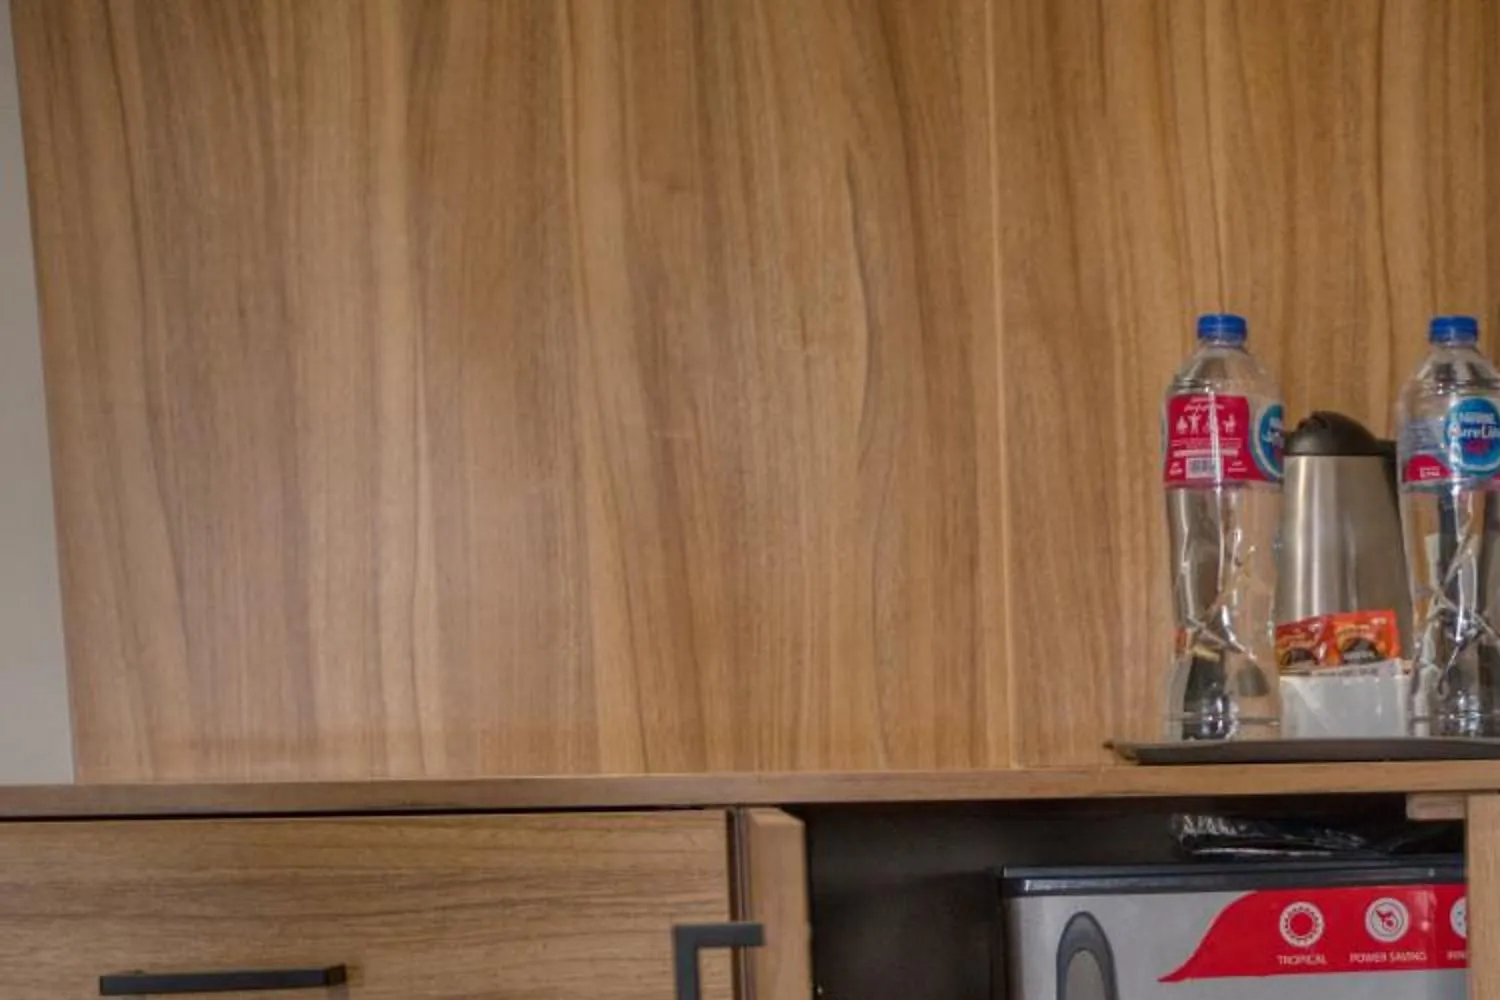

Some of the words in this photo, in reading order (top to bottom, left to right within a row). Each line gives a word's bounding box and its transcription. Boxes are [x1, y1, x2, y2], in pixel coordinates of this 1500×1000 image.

[1276, 953, 1328, 966] TROPICAL
[1349, 951, 1388, 963] POWER
[1389, 950, 1428, 962] SAVING
